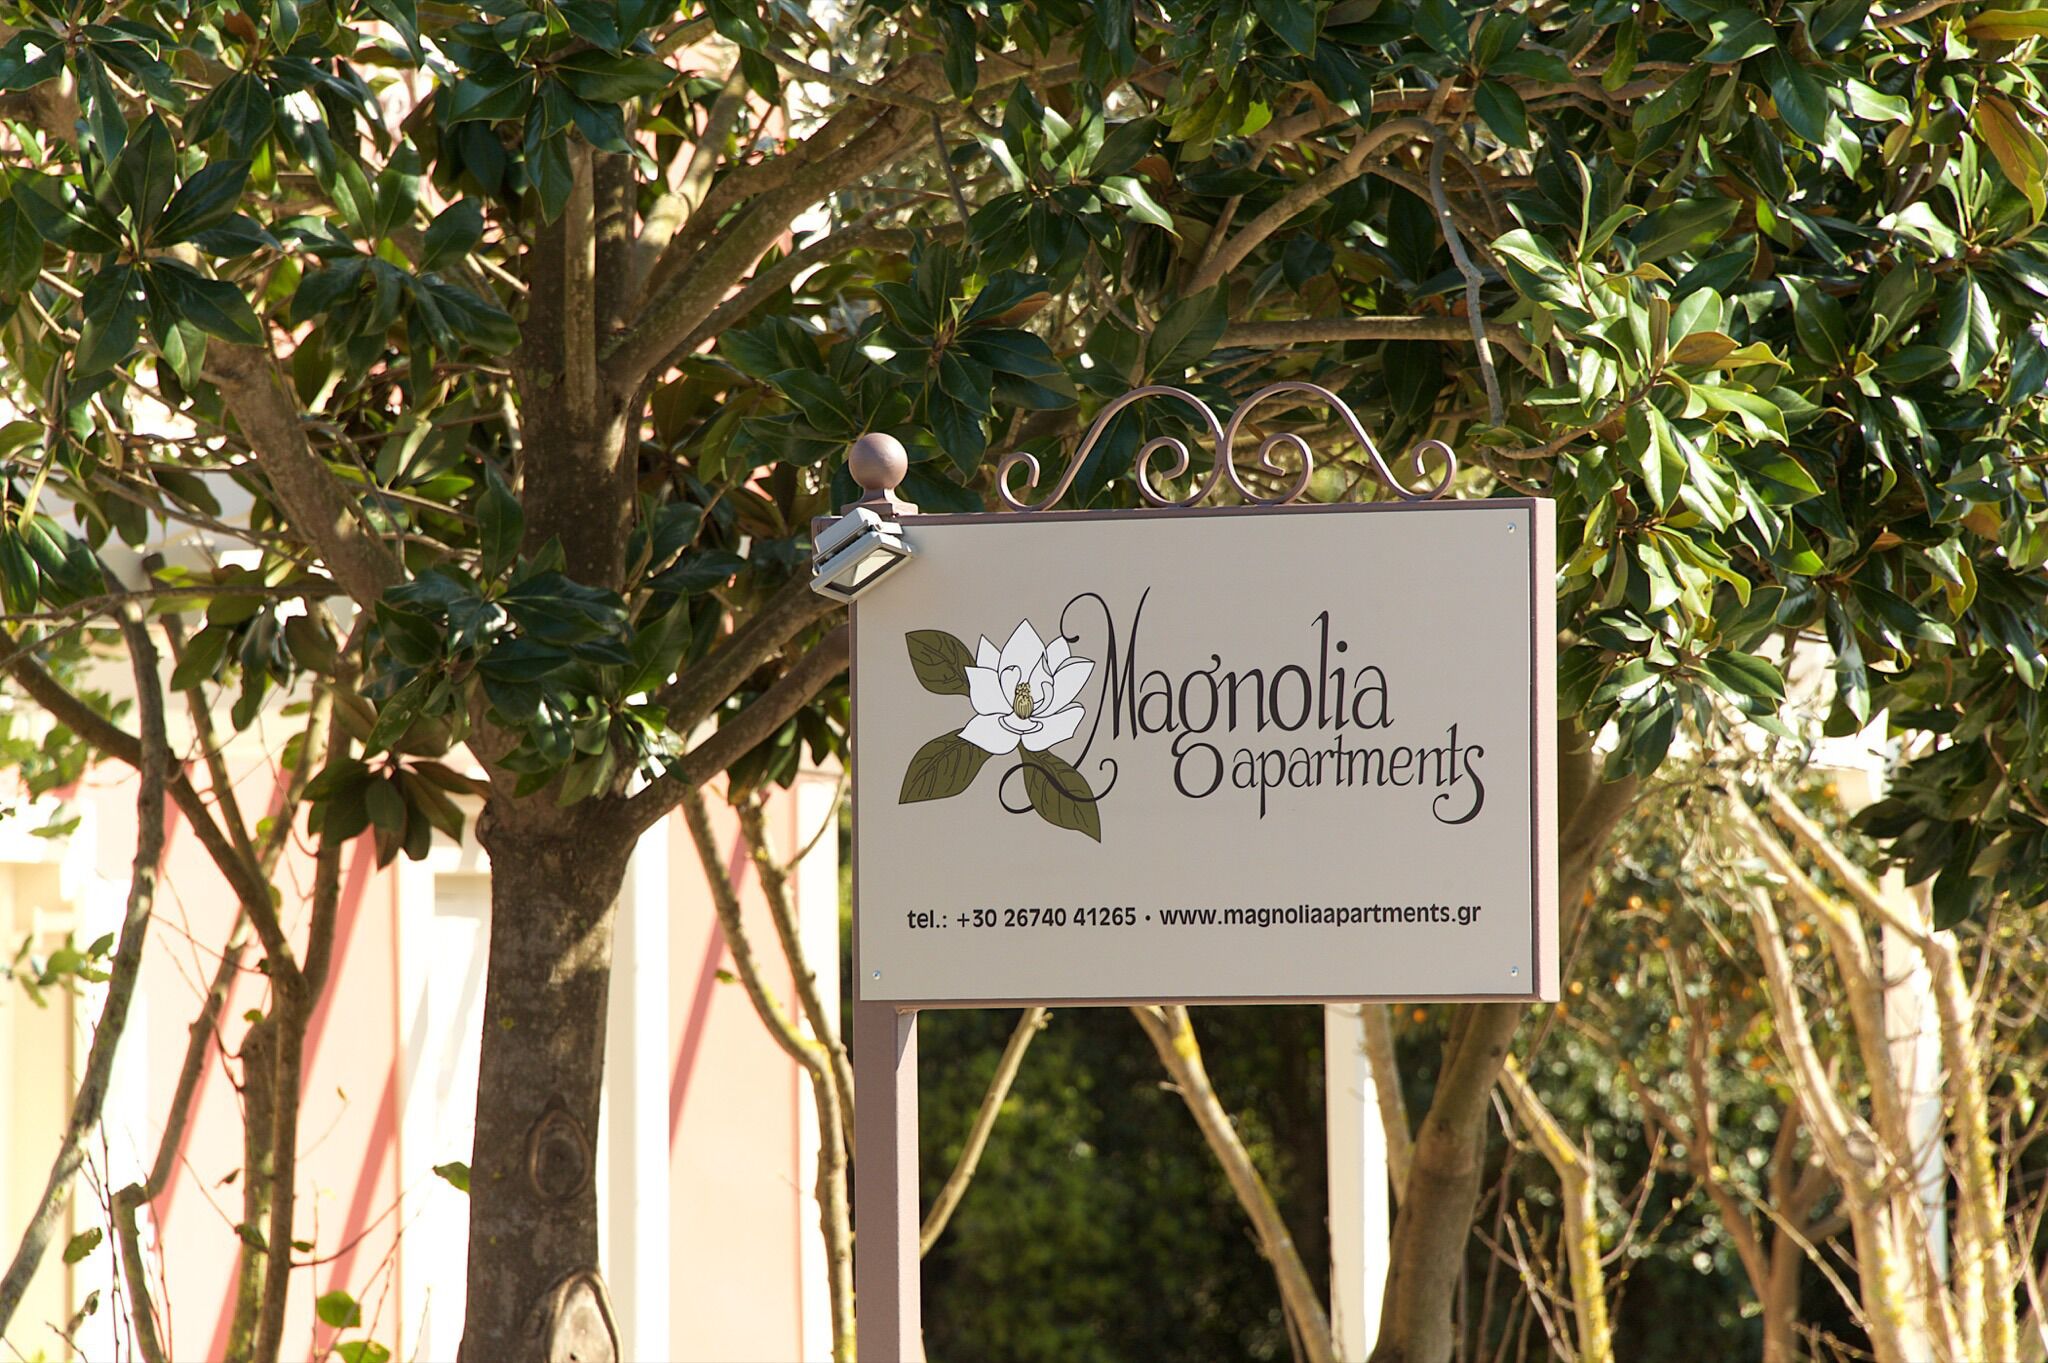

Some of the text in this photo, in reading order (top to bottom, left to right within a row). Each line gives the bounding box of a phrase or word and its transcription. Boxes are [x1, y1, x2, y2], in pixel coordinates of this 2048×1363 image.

[1000, 587, 1394, 814] Magnolia
[1231, 723, 1484, 824] apartments
[906, 903, 1482, 929] tel.: +30 26740 41265 www.magnoliaapartments.gr
